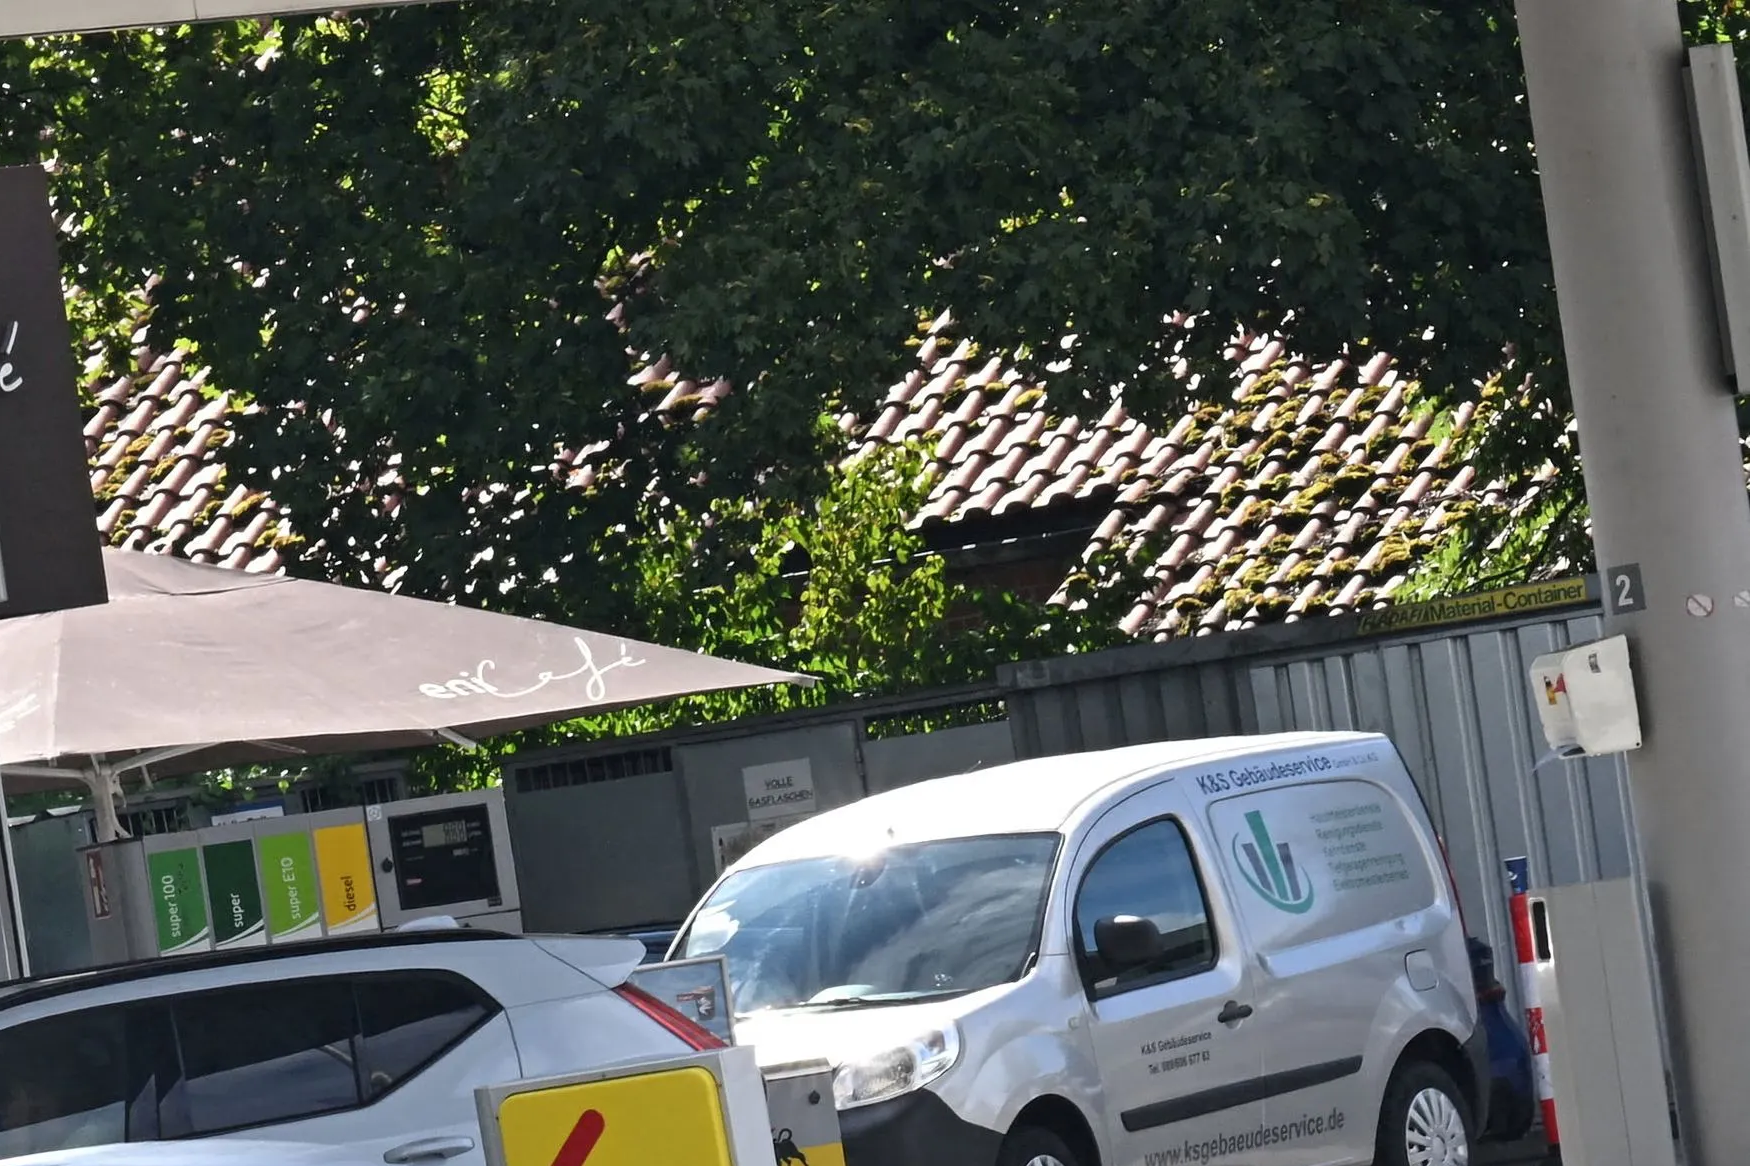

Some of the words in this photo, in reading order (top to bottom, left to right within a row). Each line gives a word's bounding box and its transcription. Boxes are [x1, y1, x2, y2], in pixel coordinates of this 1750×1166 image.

[1430, 583, 1584, 621] Material-Container
[1615, 574, 1634, 606] 2
[764, 776, 794, 791] VOLLE
[1196, 774, 1230, 795] K&S
[1230, 754, 1332, 786] Gebäudeservice
[161, 875, 176, 900] 100
[281, 857, 295, 883] E10
[230, 892, 244, 929] super
[289, 884, 301, 921] super
[340, 875, 357, 912] diesel
[167, 900, 182, 938] super
[1157, 1031, 1212, 1052] Gebäudeservice
